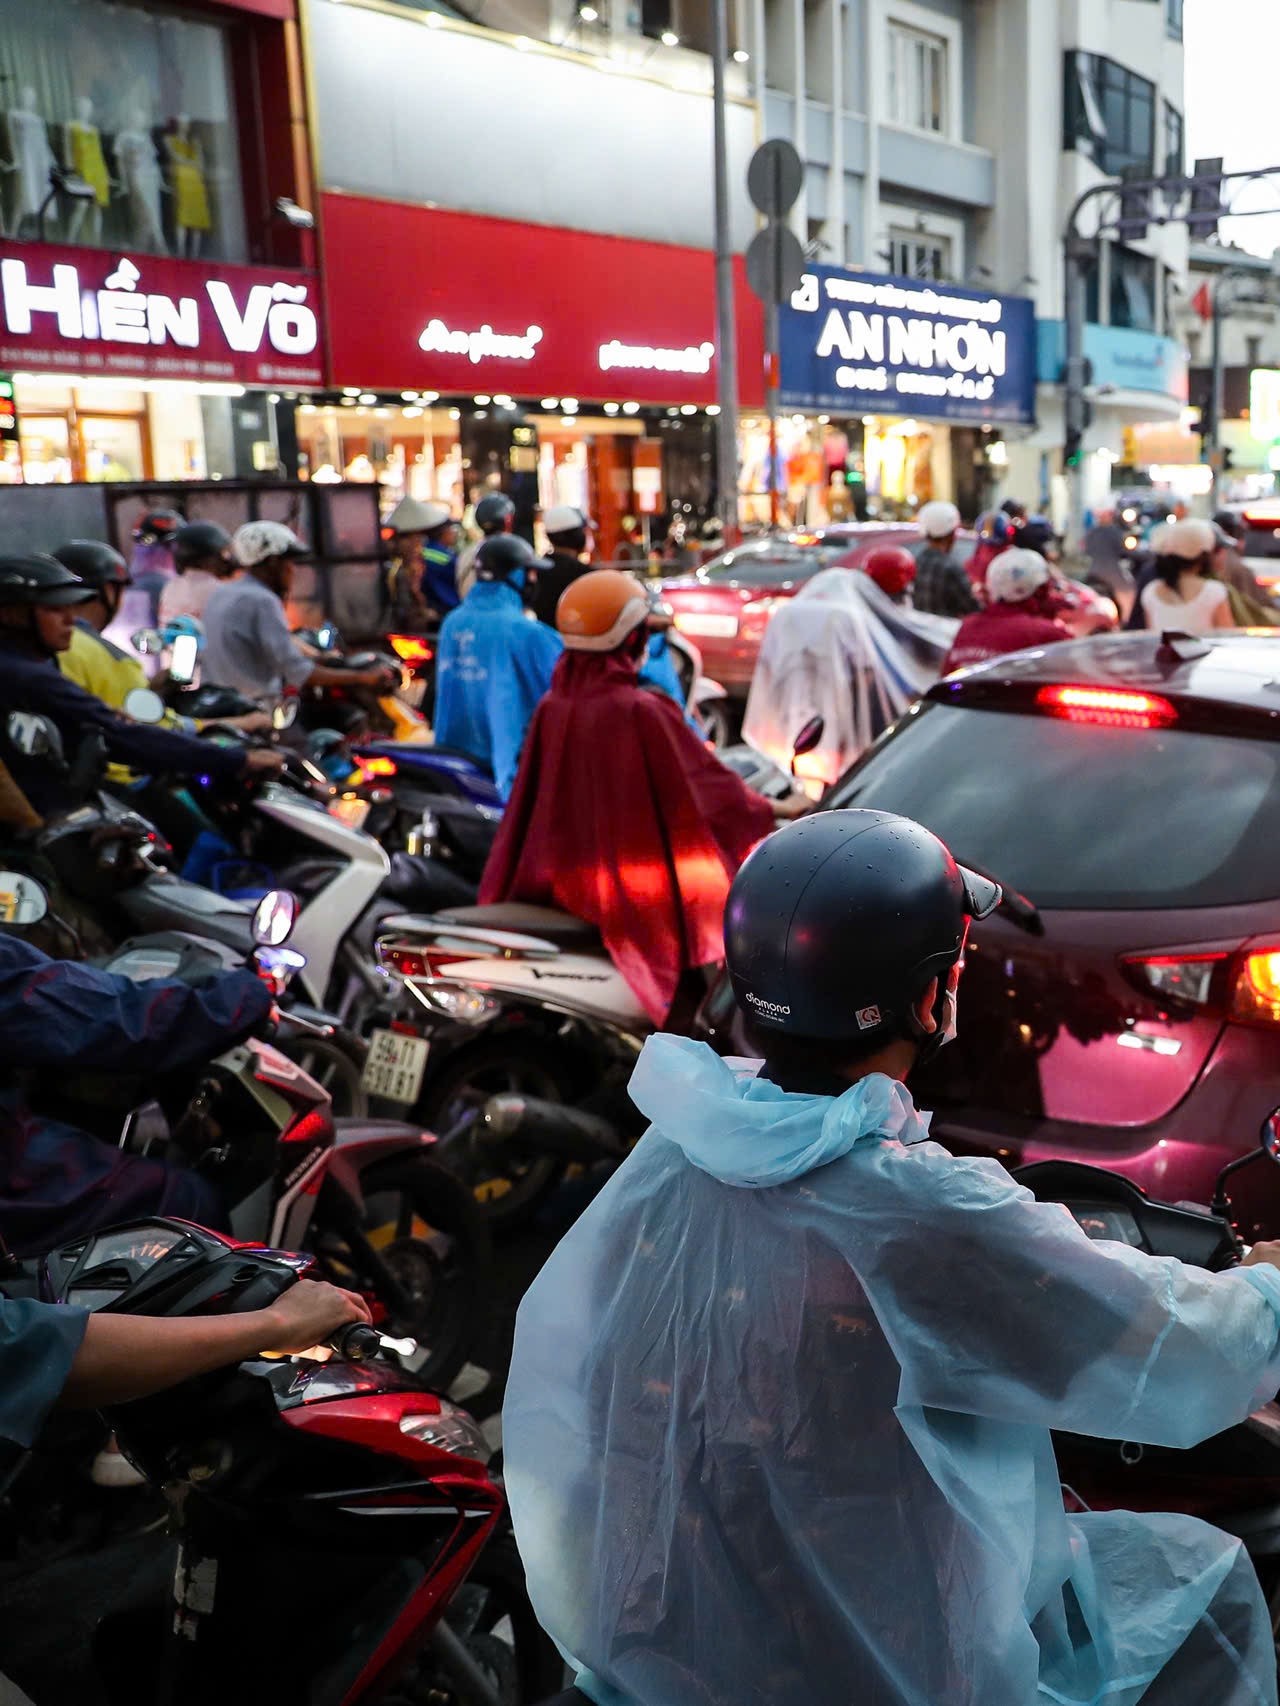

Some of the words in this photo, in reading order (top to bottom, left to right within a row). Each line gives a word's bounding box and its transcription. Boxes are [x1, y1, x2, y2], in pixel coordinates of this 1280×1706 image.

[1, 257, 200, 349] HIỀN
[206, 278, 318, 354] VÕ
[745, 992, 791, 1015] diamond
